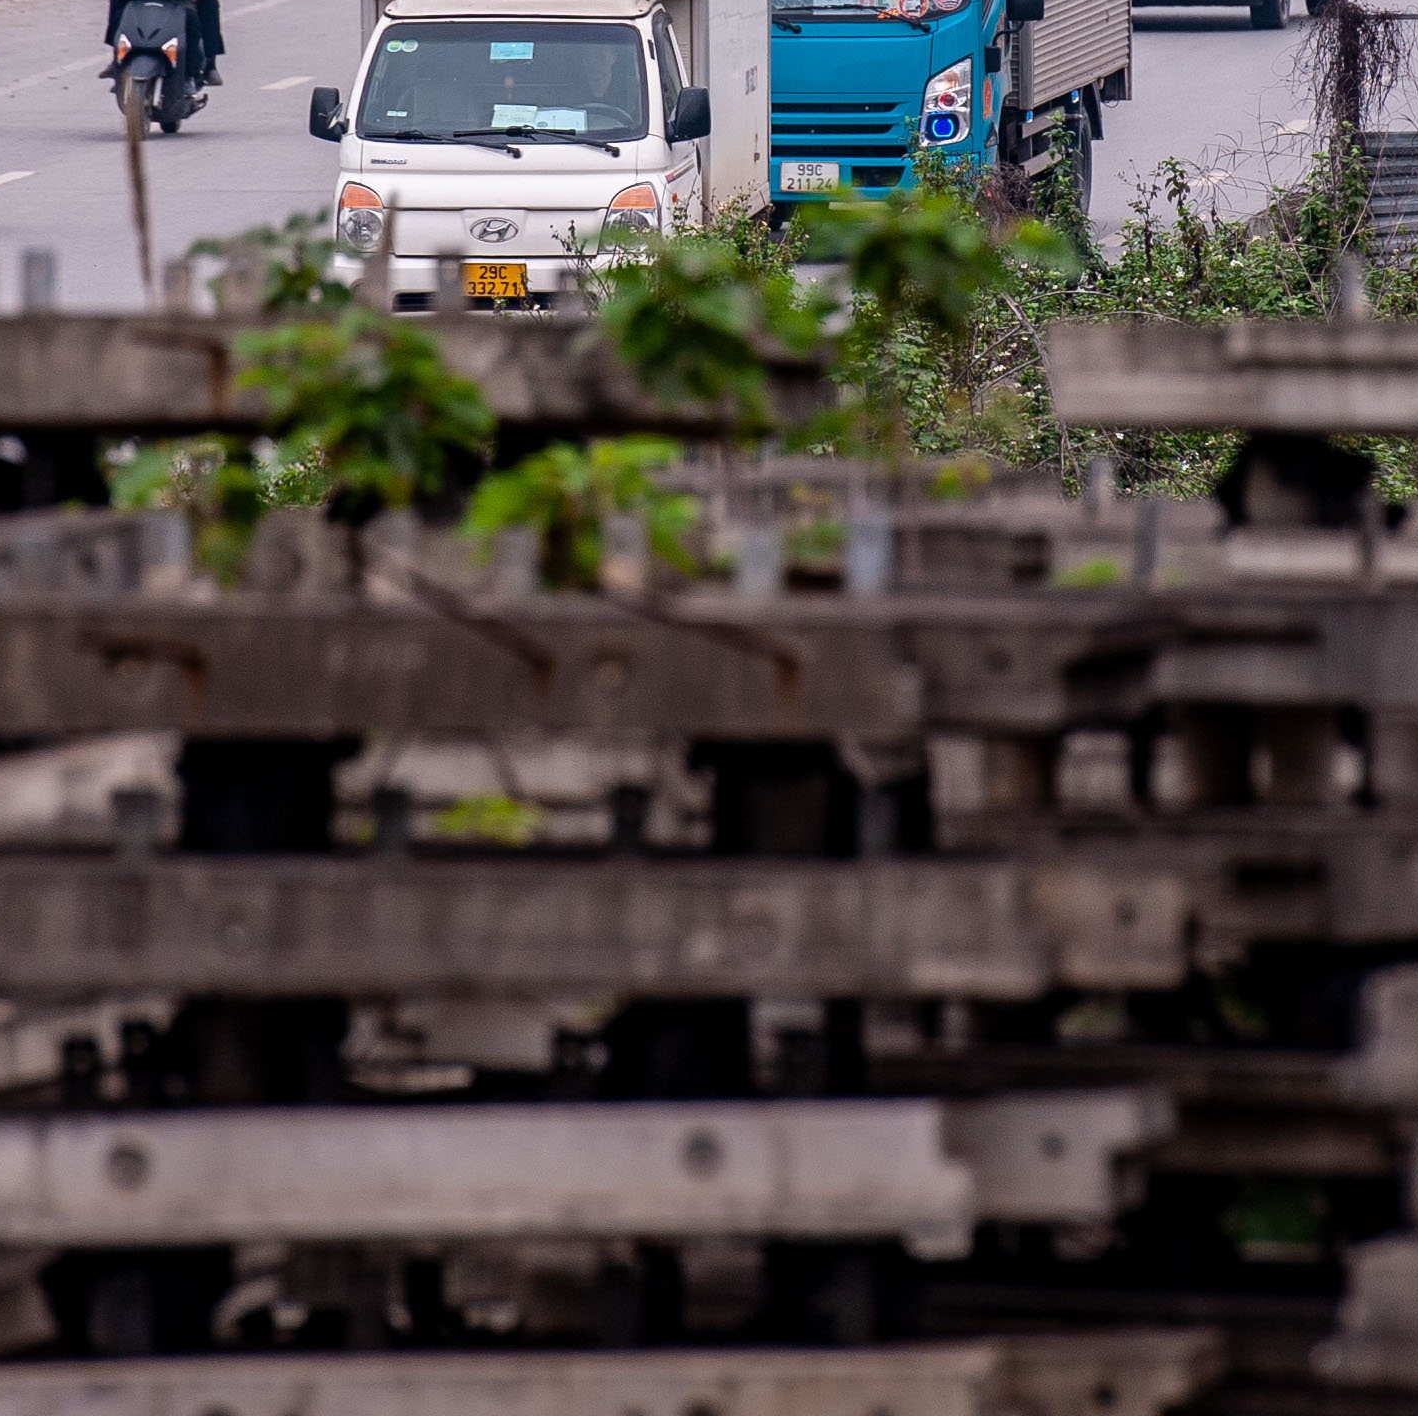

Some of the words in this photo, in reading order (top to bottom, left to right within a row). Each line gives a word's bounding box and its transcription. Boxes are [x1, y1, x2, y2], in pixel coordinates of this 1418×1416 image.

[797, 164, 823, 176] 99C
[479, 265, 508, 279] 29C
[468, 281, 518, 295] 332.71
